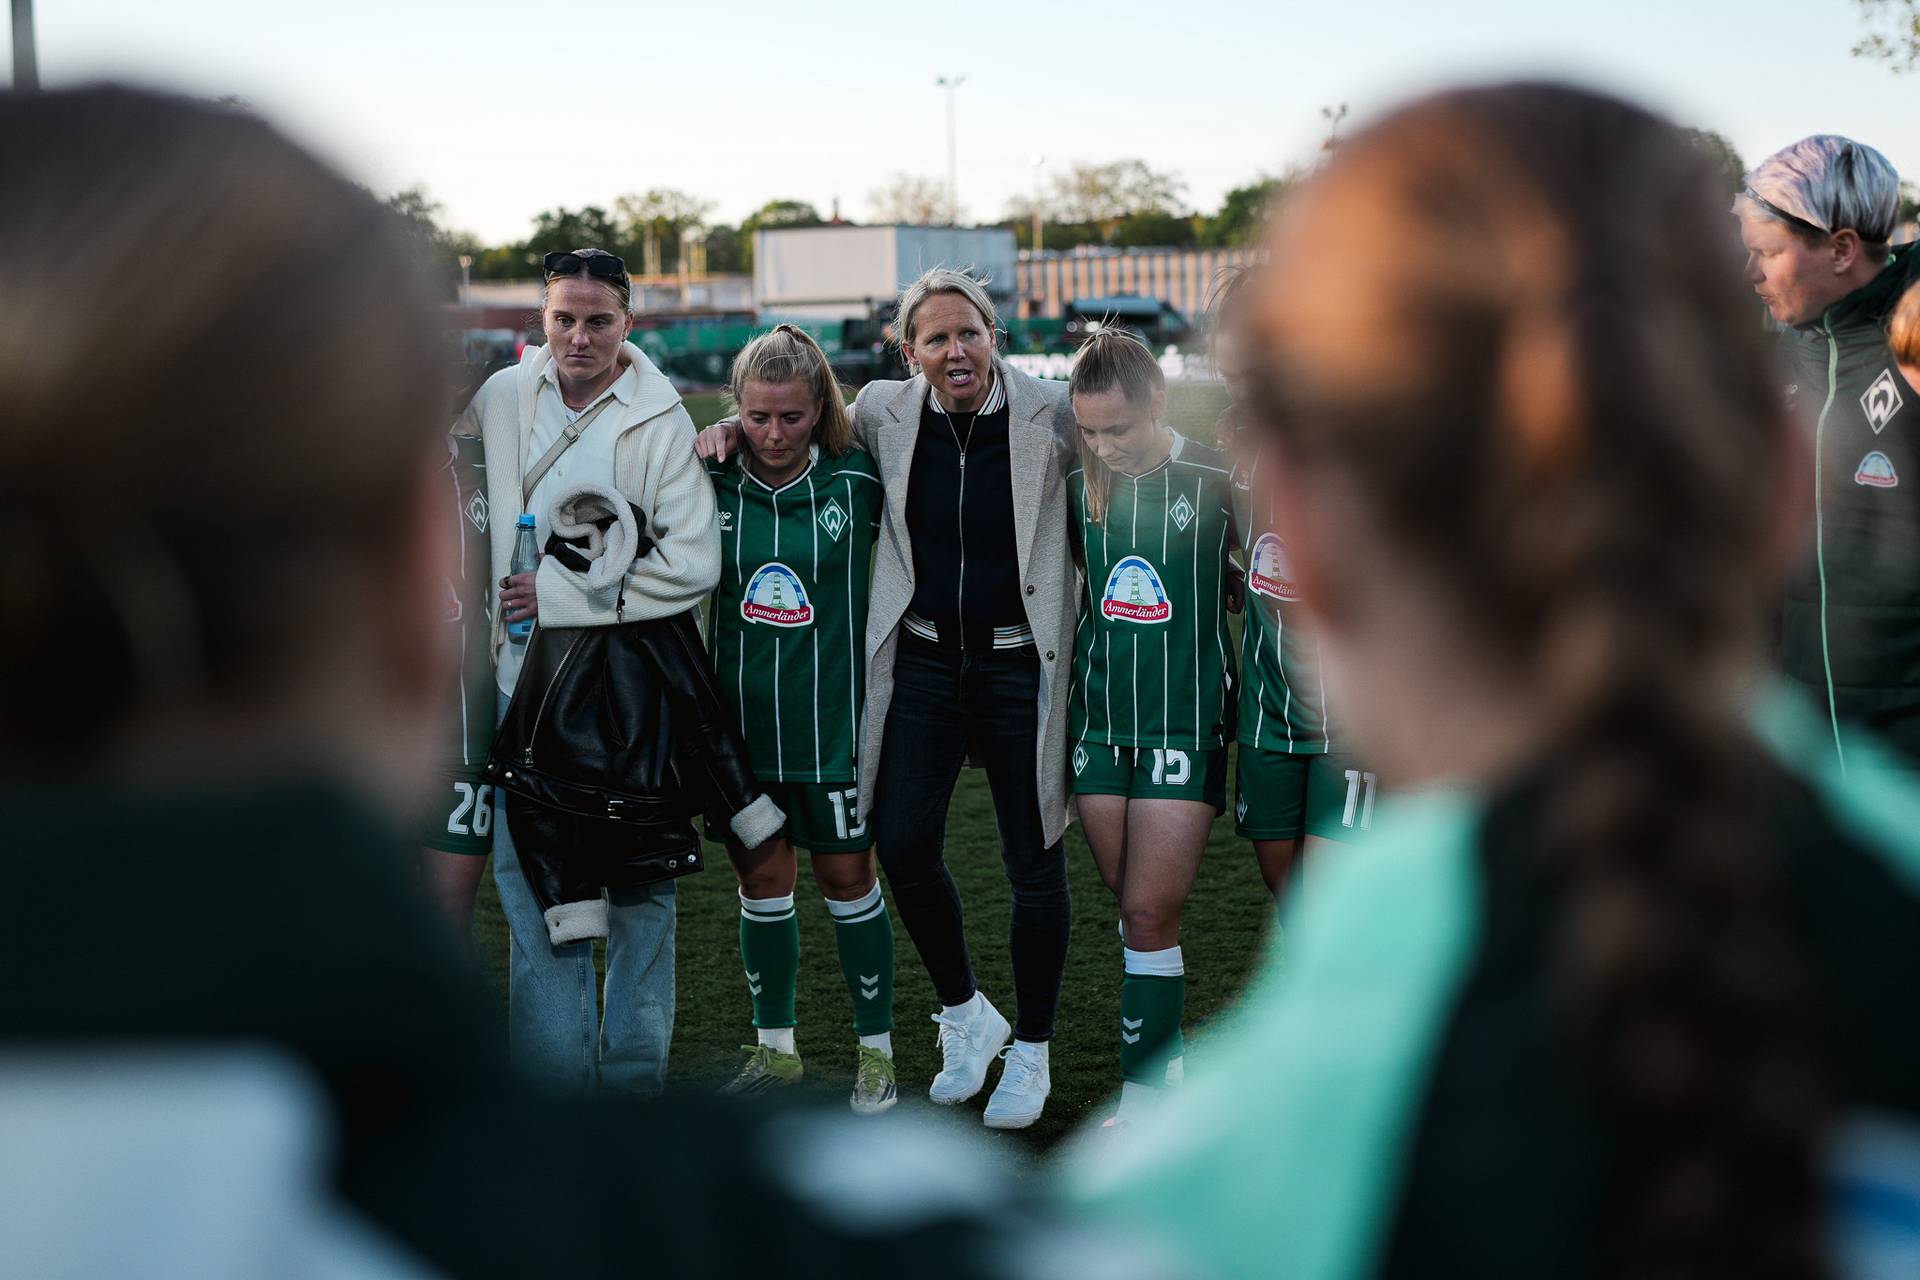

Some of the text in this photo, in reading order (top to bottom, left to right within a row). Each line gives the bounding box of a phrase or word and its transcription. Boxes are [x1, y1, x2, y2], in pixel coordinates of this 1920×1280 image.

[745, 604, 809, 621] Ammerländer
[1104, 602, 1167, 618] Ammerländer
[447, 782, 492, 836] 26
[1342, 769, 1377, 831] 11
